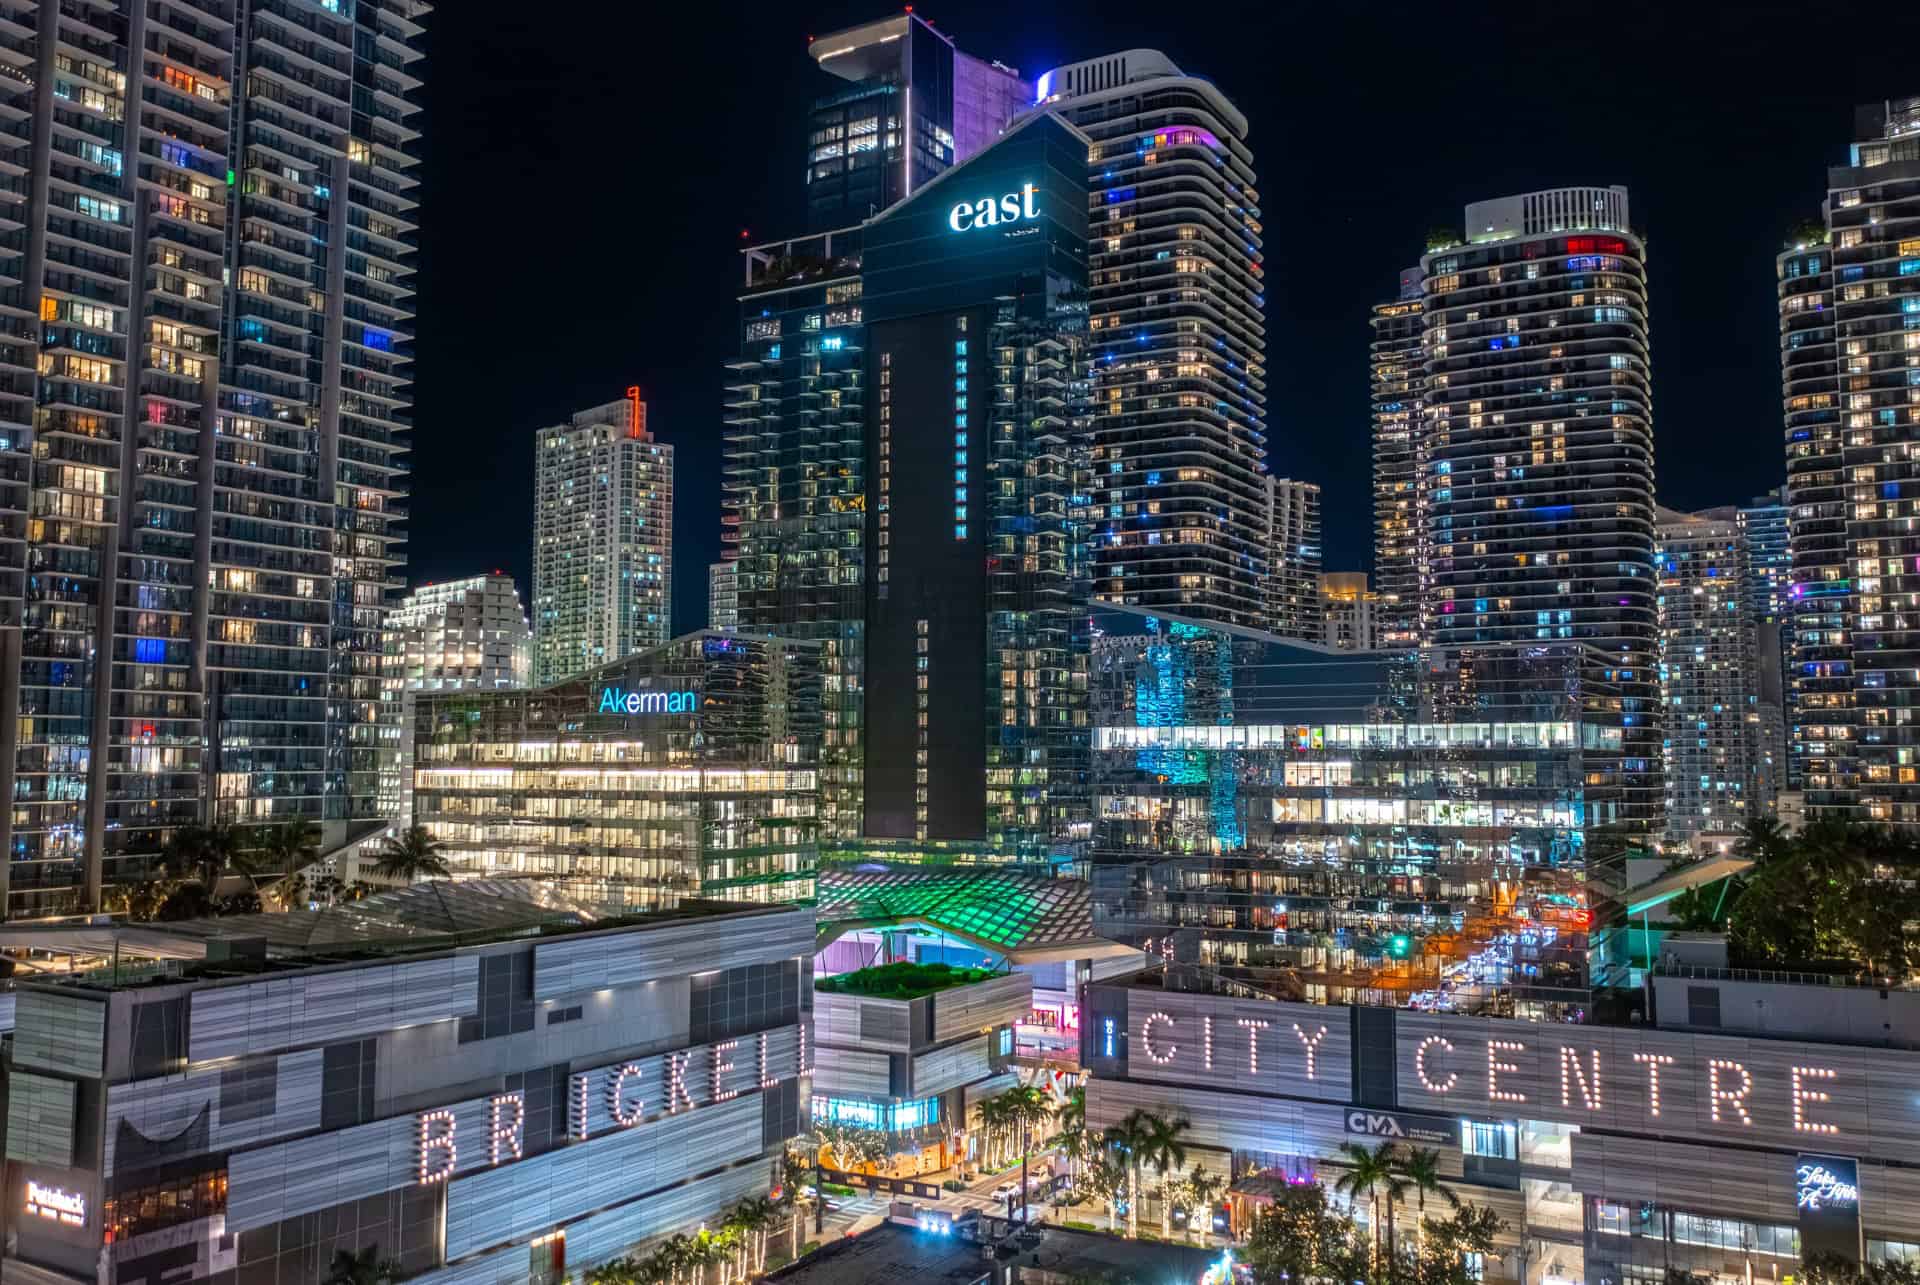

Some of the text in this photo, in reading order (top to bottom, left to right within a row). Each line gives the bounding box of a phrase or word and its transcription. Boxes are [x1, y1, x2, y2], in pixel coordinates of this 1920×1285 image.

[949, 183, 1041, 232] east
[598, 687, 696, 713] Akerman
[1143, 1012, 1839, 1134] CITY CENTRE
[420, 1024, 816, 1184] BRICKELL
[1348, 1112, 1405, 1137] CMX
